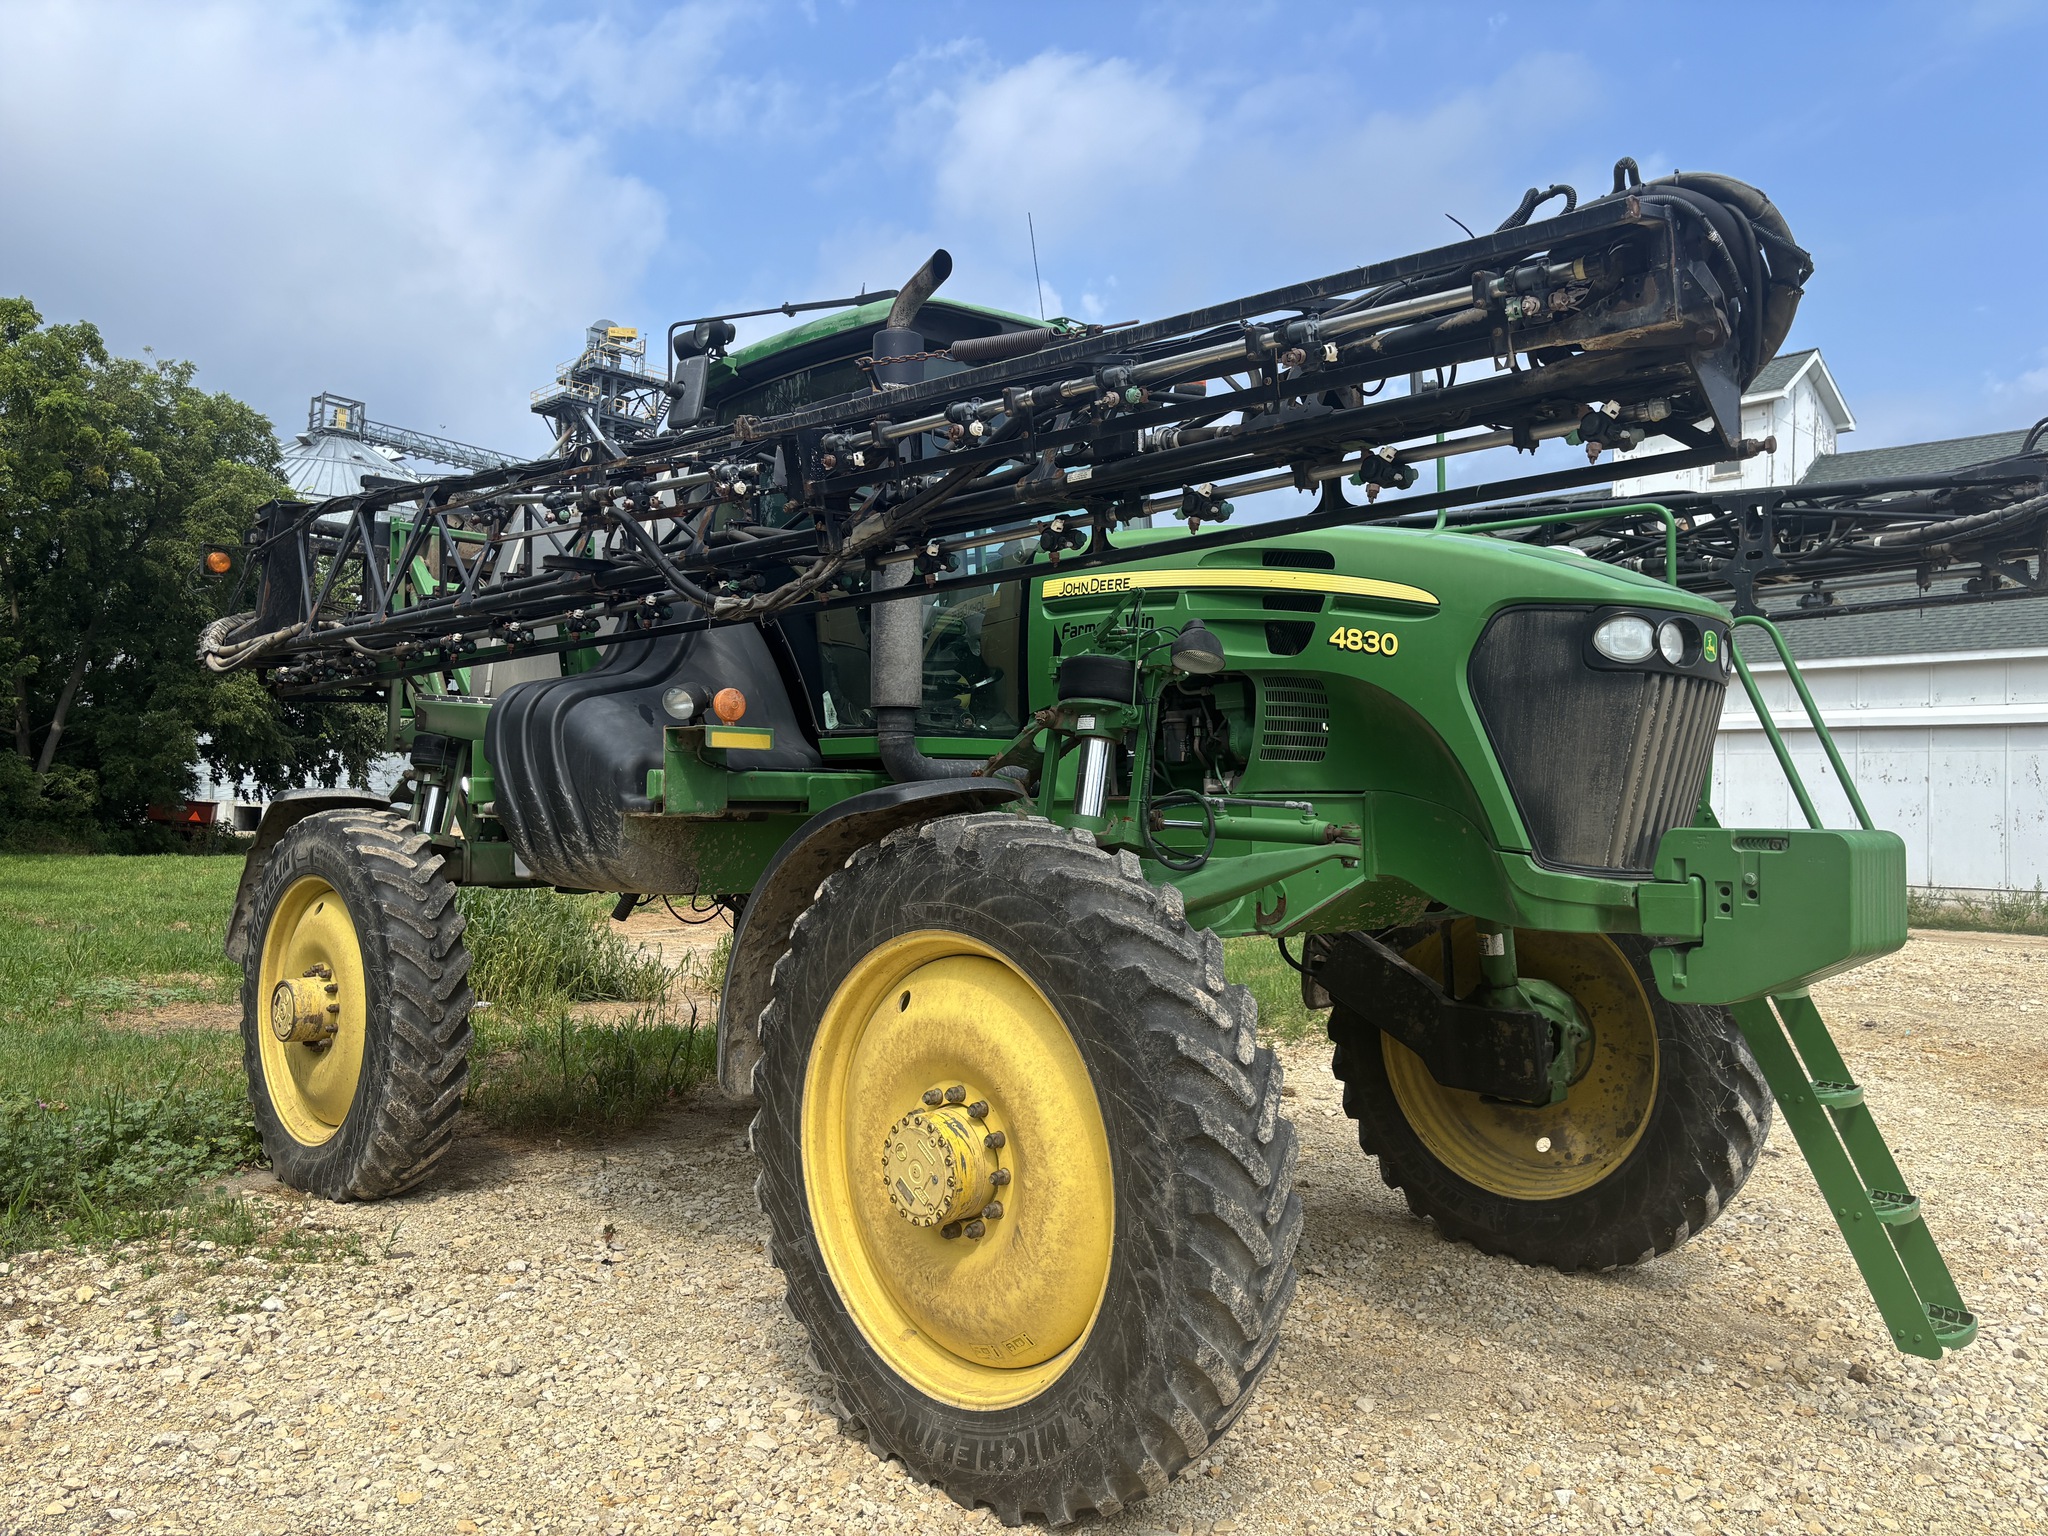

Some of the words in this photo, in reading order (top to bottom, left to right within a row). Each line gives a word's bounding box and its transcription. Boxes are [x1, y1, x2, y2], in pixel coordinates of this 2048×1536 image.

[1059, 581, 1089, 595] JOHN
[1090, 577, 1131, 592] DEERE
[1062, 621, 1102, 640] Farm
[1328, 626, 1399, 657] 4830
